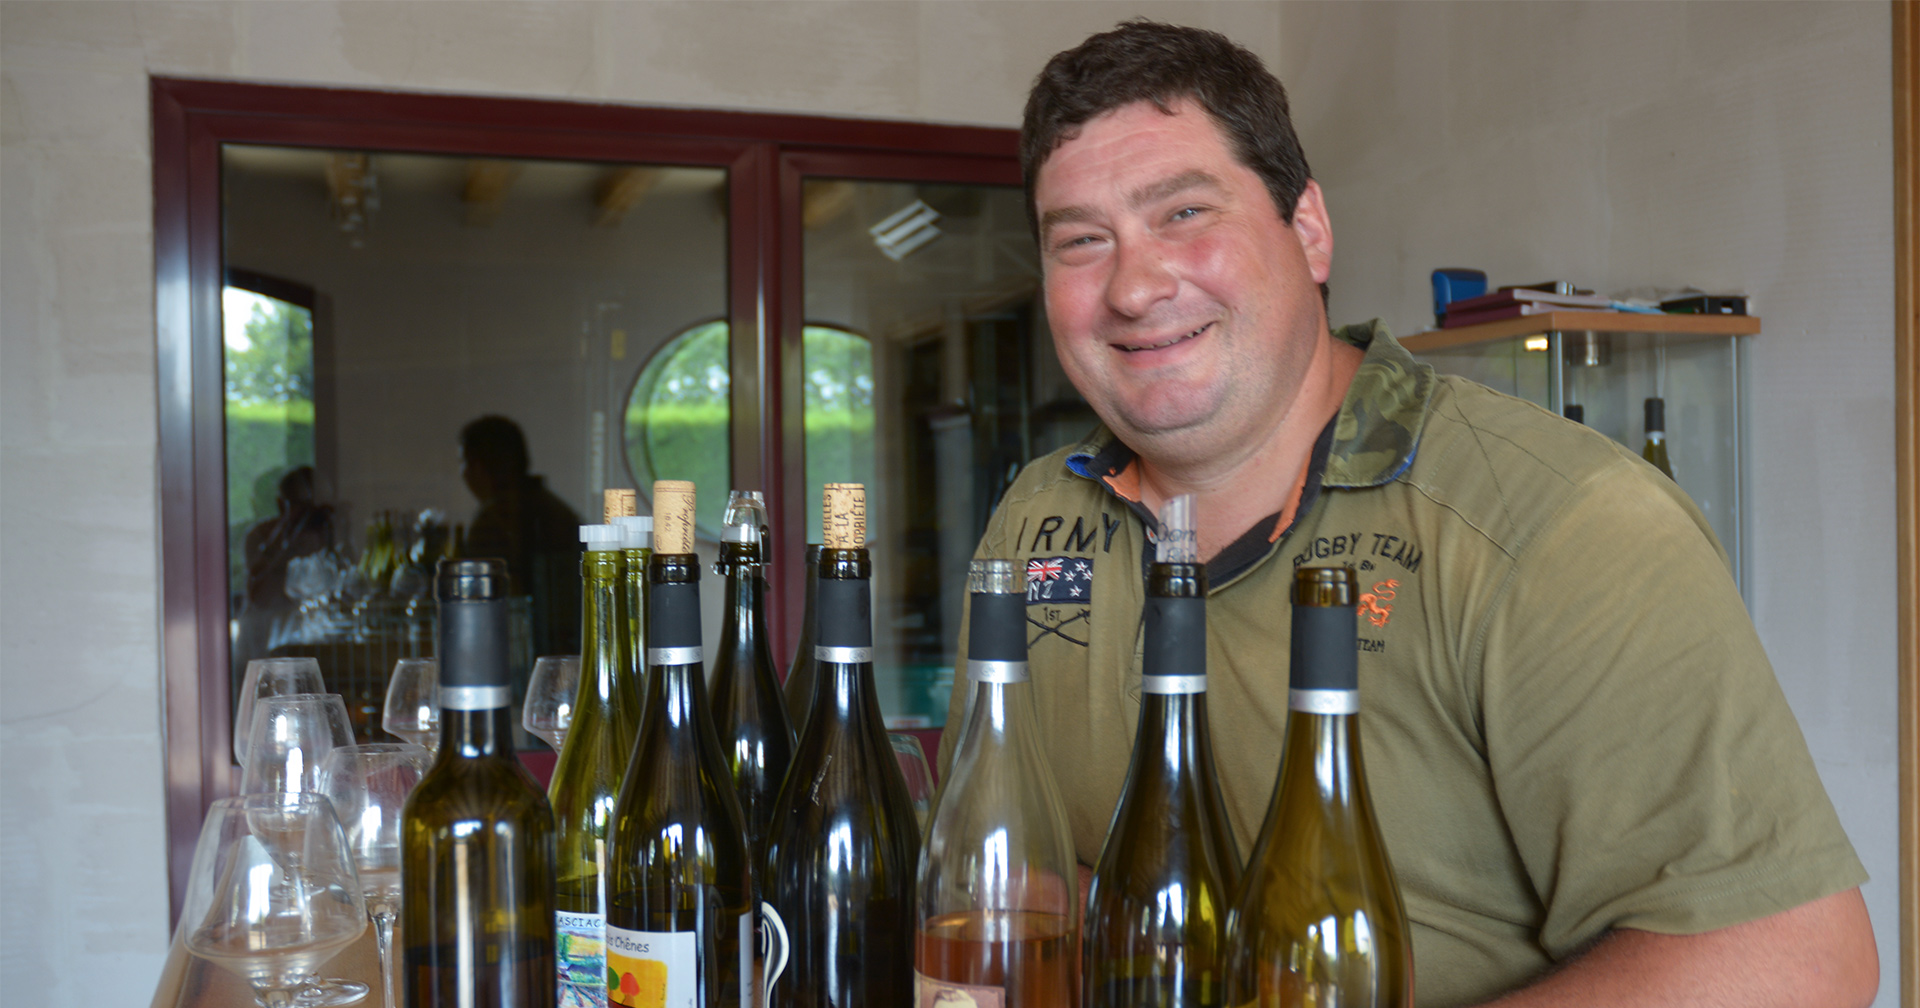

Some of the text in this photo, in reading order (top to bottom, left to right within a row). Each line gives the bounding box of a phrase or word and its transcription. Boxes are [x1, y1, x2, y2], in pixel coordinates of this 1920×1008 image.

[1016, 512, 1121, 554] RMY
[1371, 533, 1423, 574] TEAM
[1026, 580, 1054, 601] NZ
[615, 935, 650, 953] Chênes
